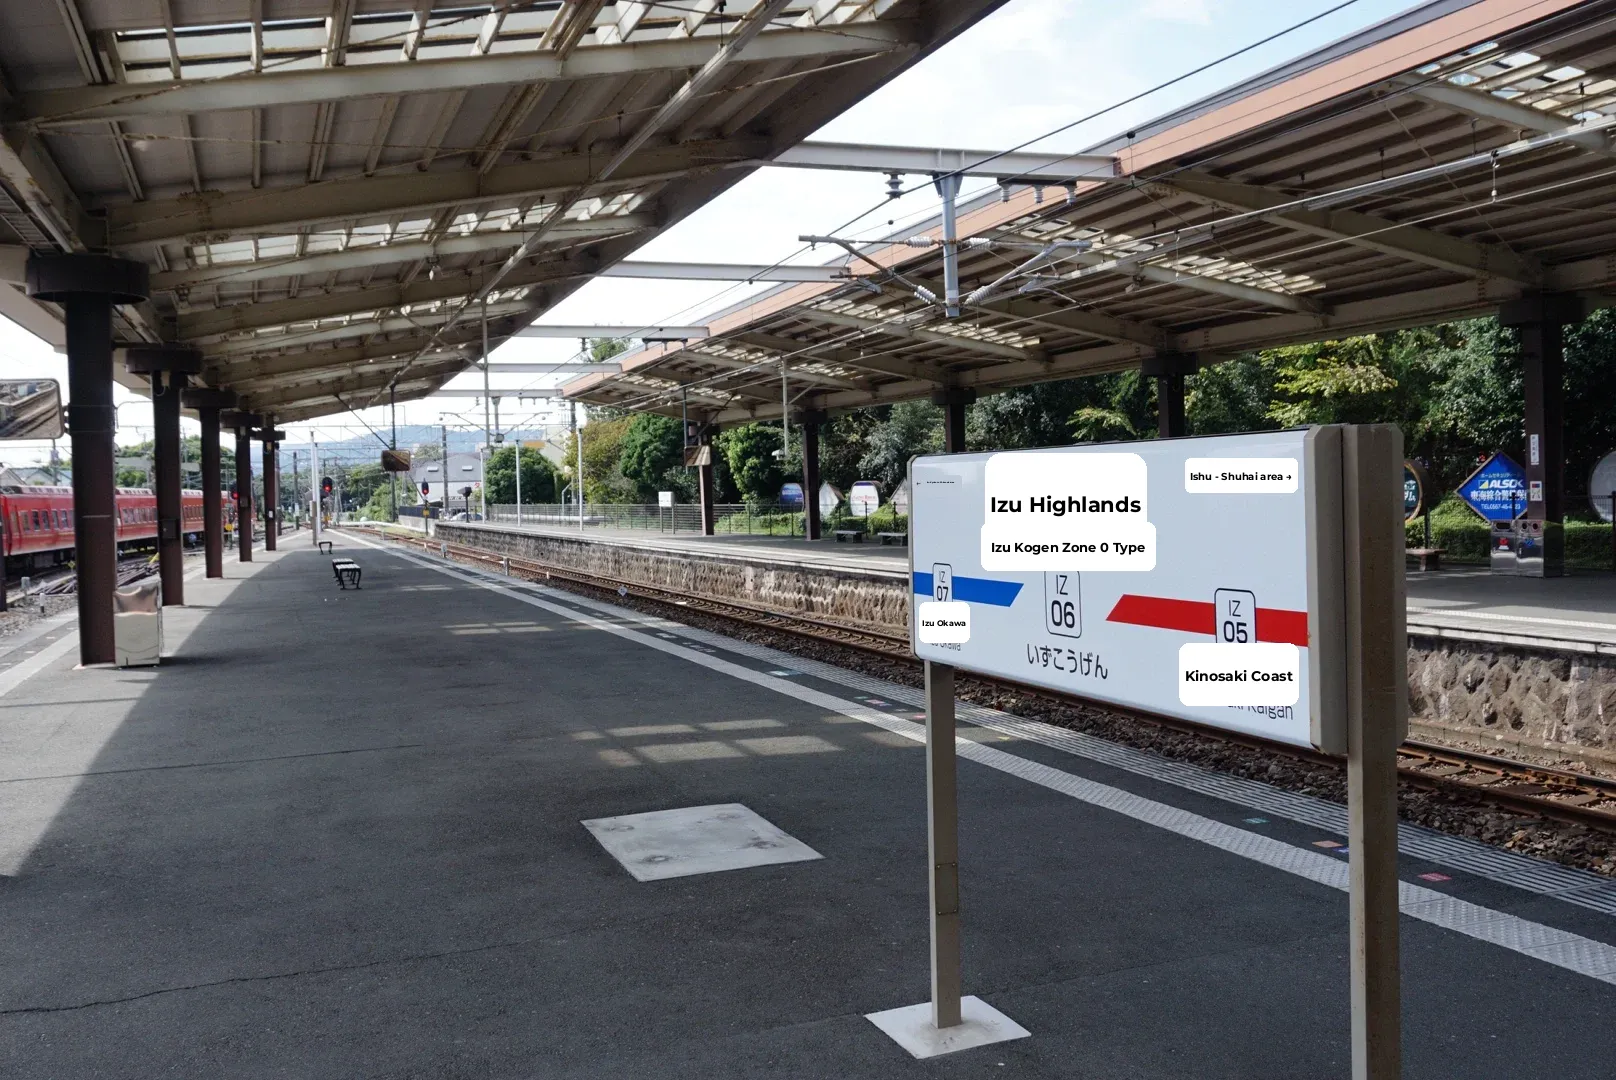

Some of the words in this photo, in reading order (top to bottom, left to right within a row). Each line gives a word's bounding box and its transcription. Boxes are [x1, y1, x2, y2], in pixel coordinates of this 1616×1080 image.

[1489, 479, 1524, 488] ALSOK
[939, 570, 946, 583] IZ
[1056, 575, 1068, 595] IZ
[936, 586, 949, 602] 07
[1051, 600, 1075, 629] 06
[1228, 600, 1242, 618] IZ
[1223, 620, 1248, 643] 05
[1027, 643, 1108, 679] いずこうげん
